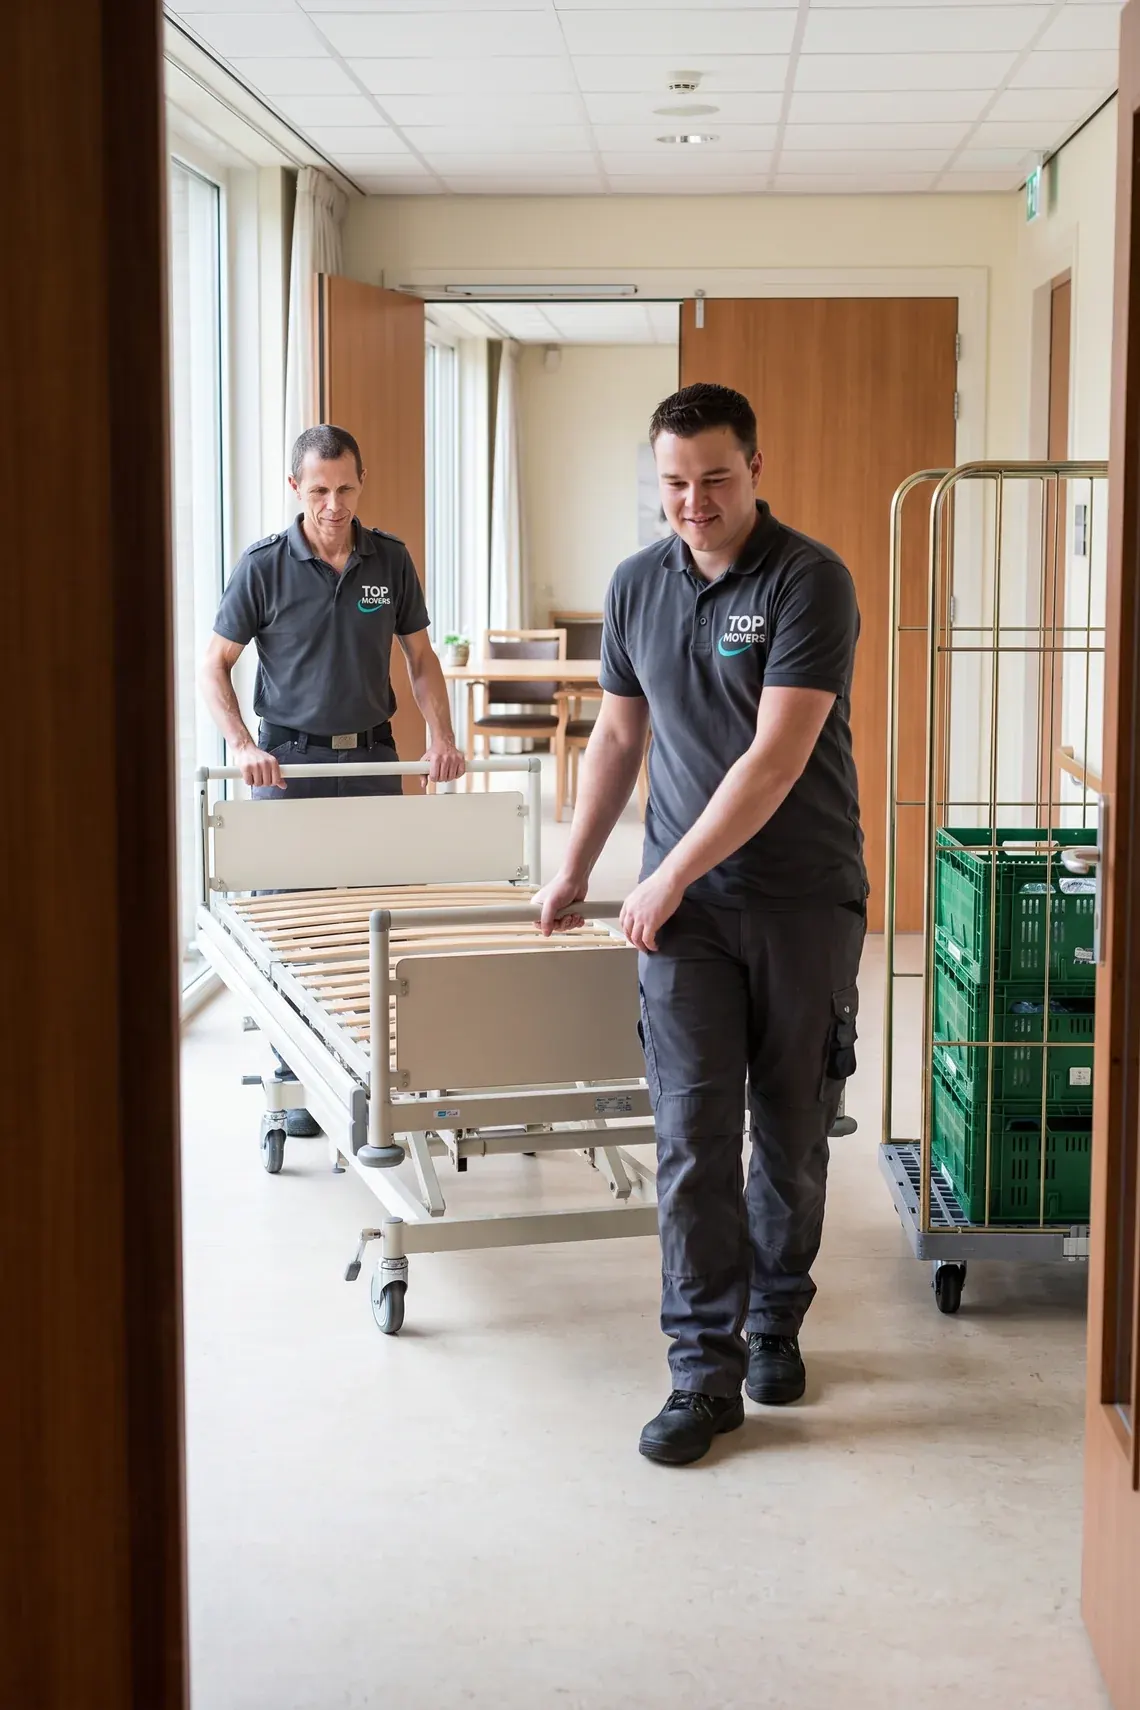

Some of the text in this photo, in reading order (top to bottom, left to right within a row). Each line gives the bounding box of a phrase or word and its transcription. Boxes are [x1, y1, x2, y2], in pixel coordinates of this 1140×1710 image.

[361, 585, 389, 598] TOP
[361, 597, 391, 605] MOVERS
[728, 615, 765, 632] TOP
[723, 632, 766, 643] MOVERS
